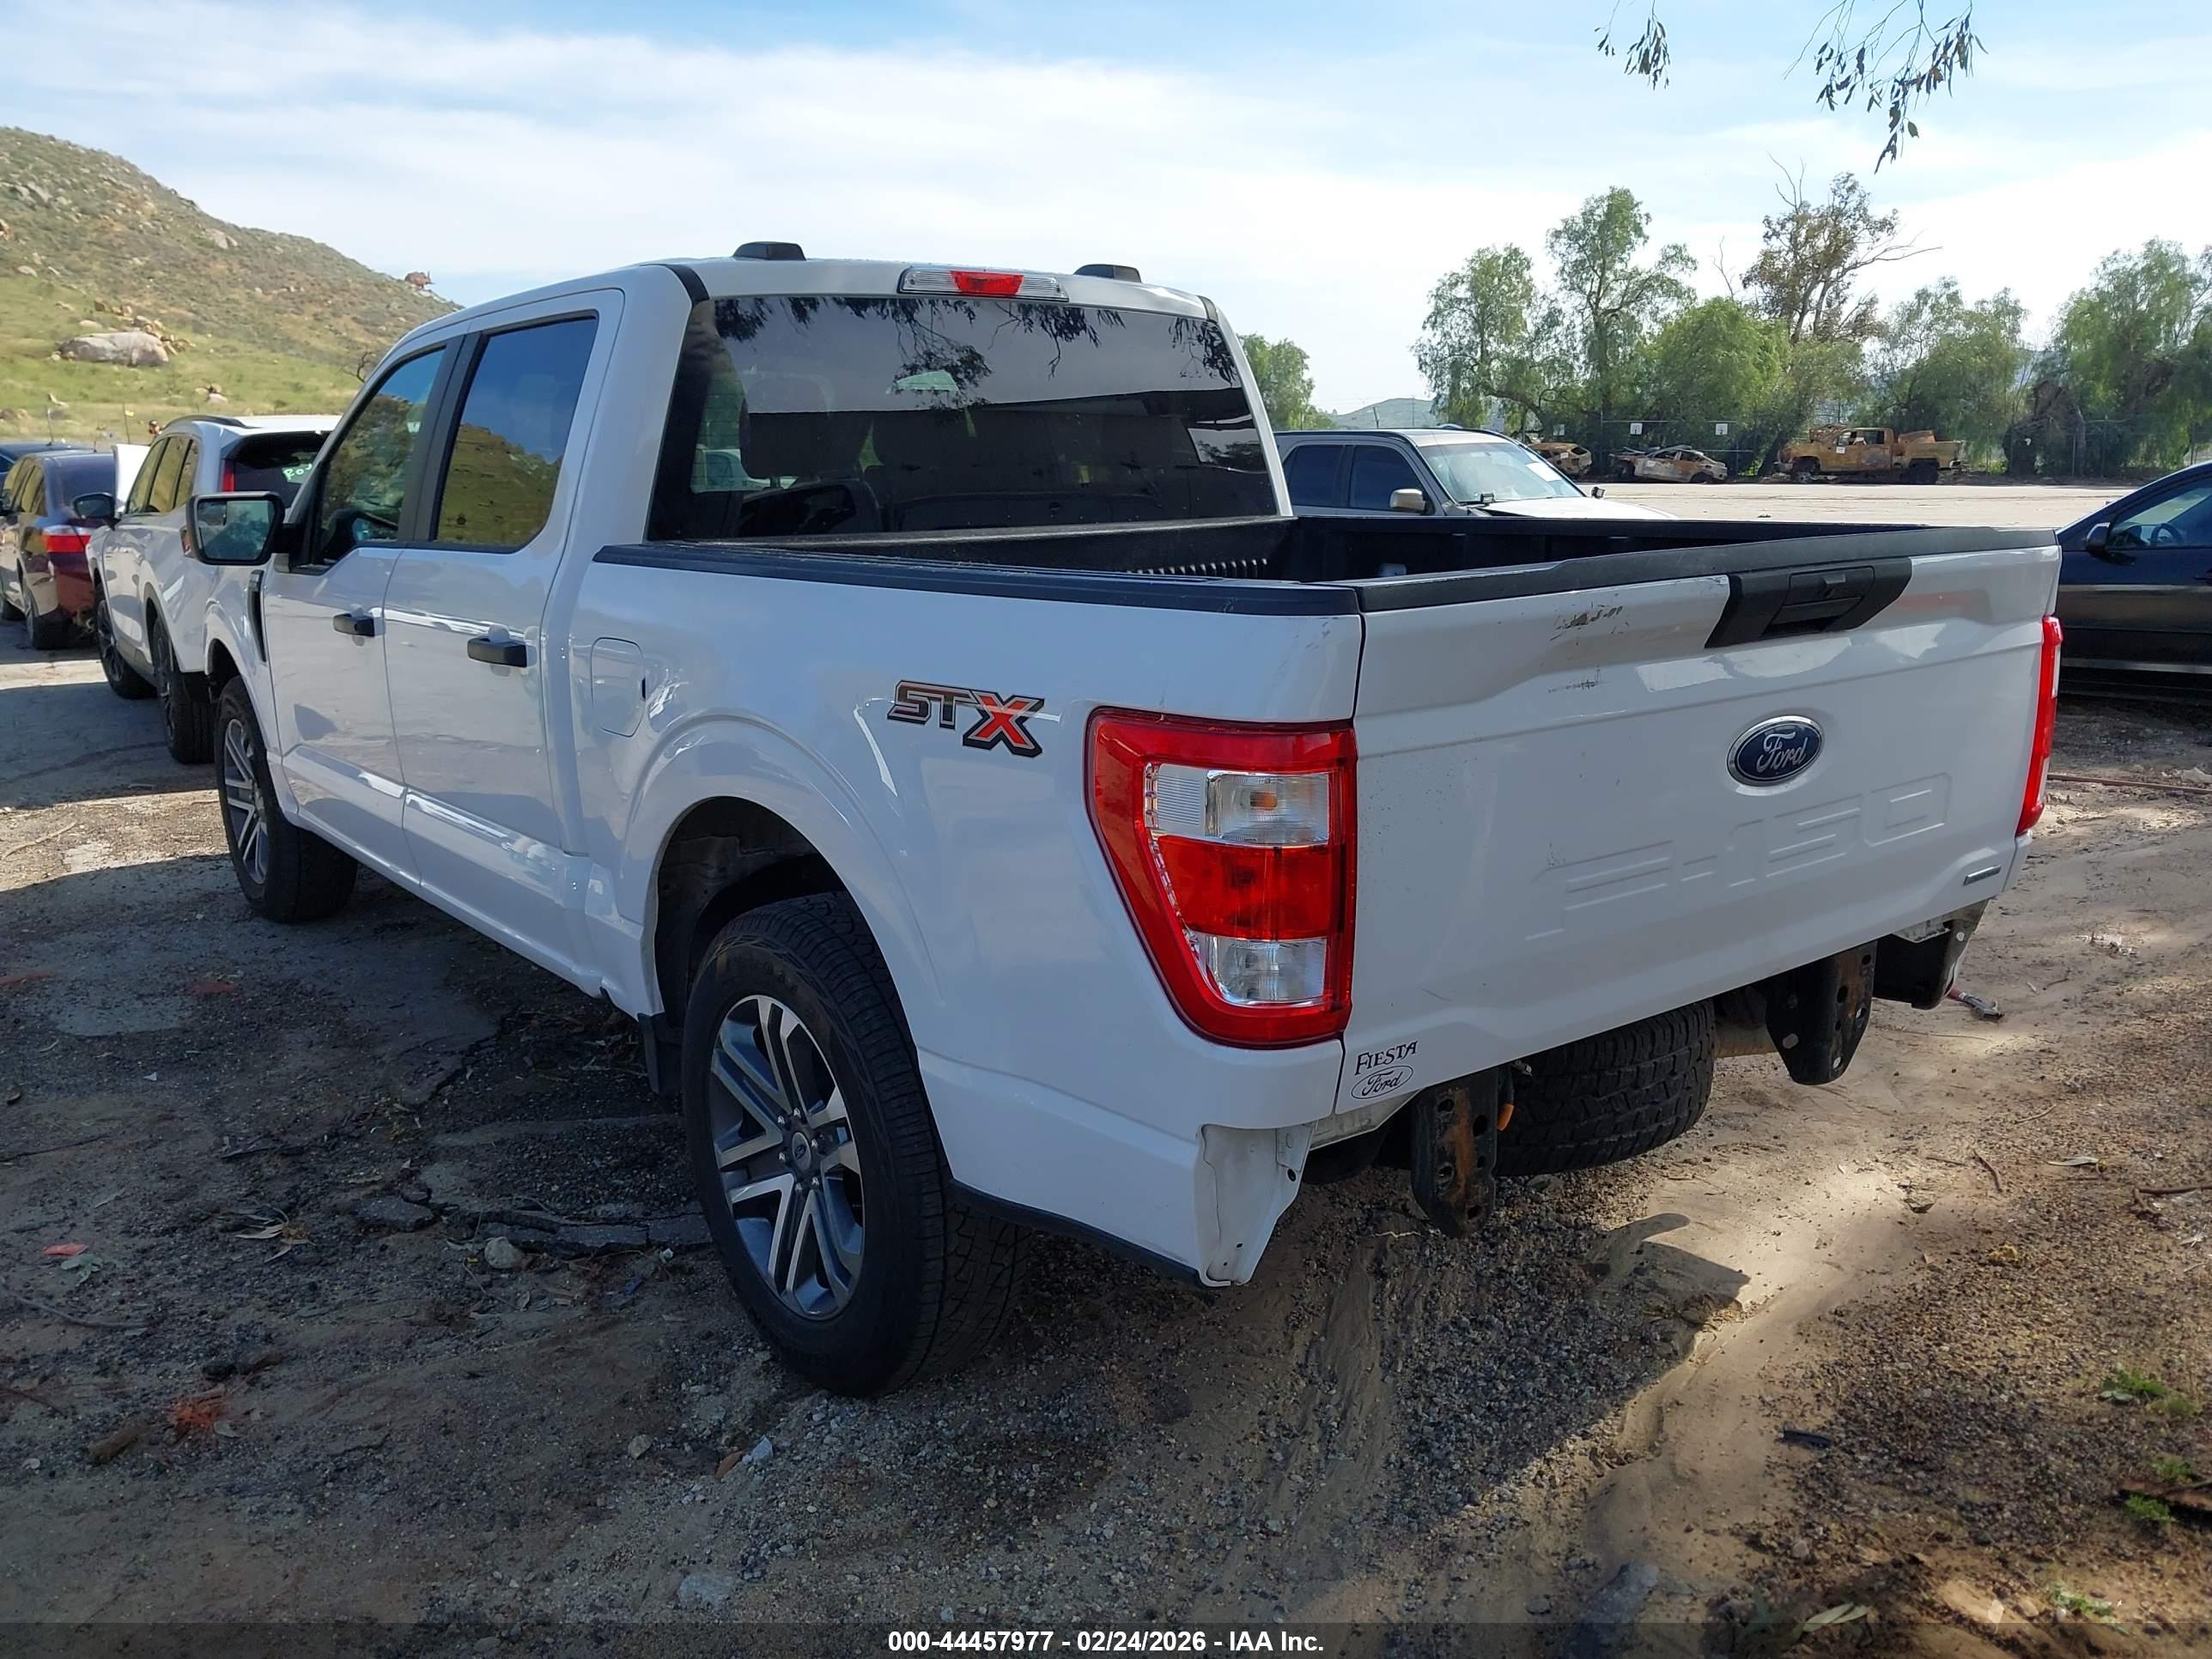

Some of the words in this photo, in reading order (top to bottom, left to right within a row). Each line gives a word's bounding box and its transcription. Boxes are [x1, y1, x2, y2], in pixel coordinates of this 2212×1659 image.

[886, 679, 1045, 758] STX
[1756, 731, 1808, 773] Ford
[1524, 772, 1952, 941] F-150
[1361, 1070, 1403, 1097] Ford
